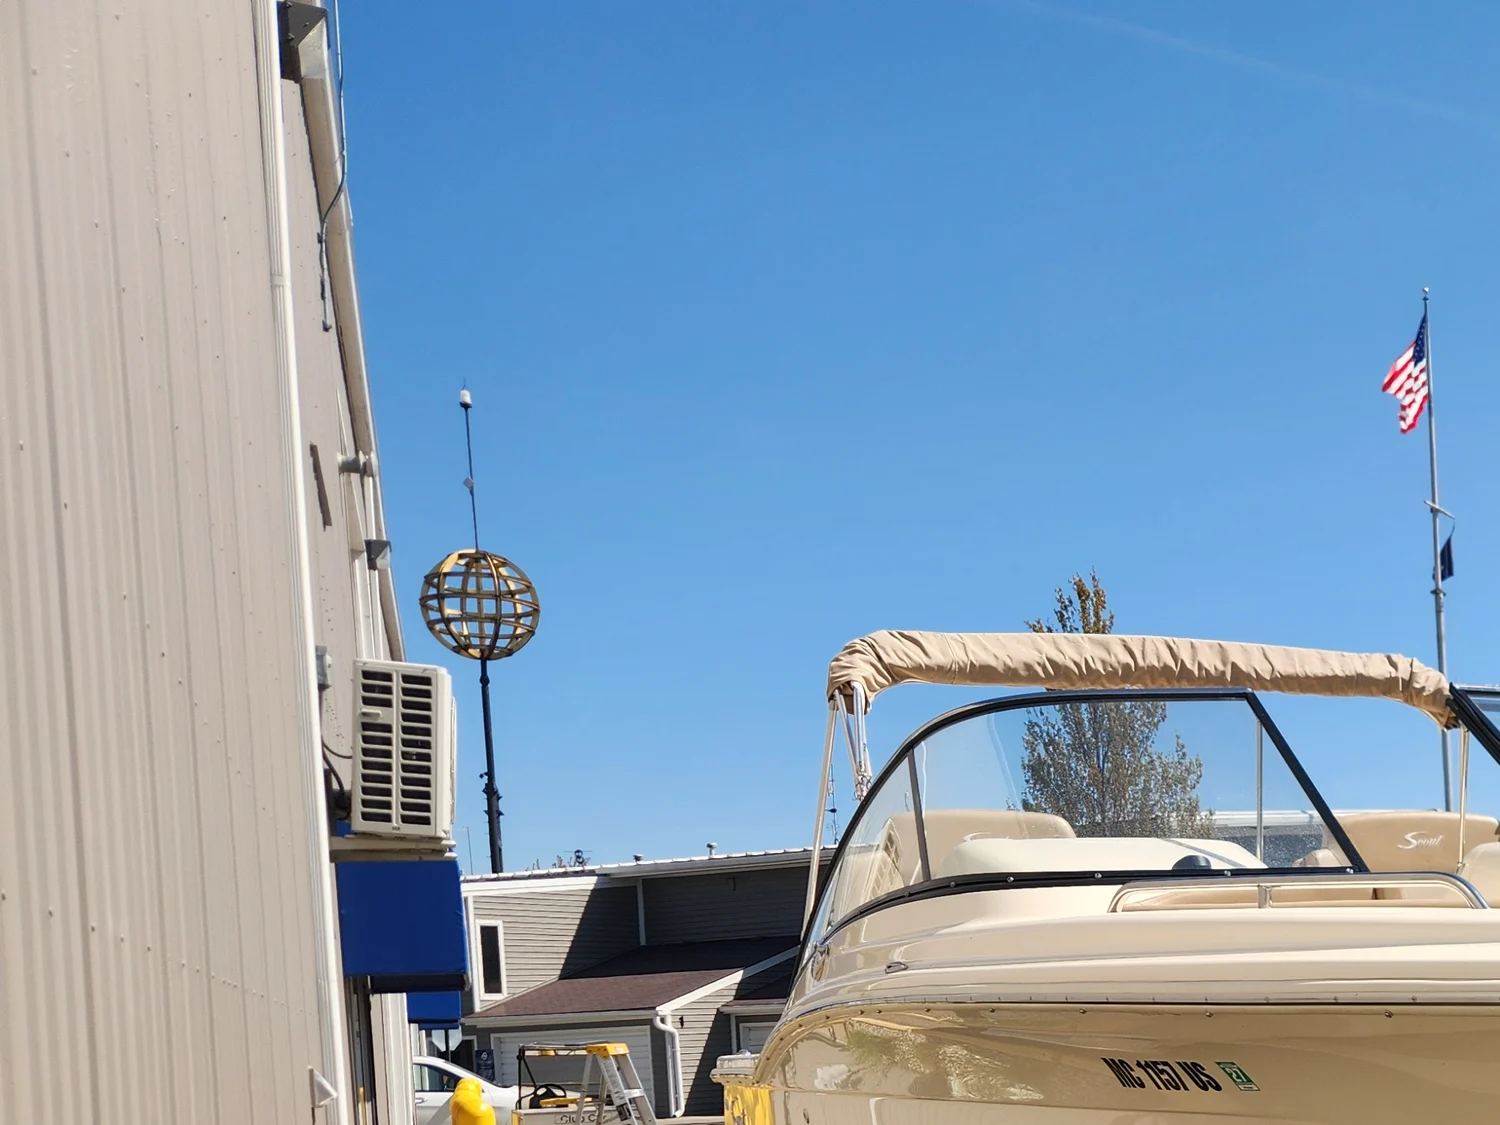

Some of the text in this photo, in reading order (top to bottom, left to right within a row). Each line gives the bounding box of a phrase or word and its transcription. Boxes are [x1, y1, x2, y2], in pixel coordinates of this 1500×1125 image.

[1100, 1057, 1223, 1092] MC 1157 US
[1224, 1067, 1247, 1082] 27
